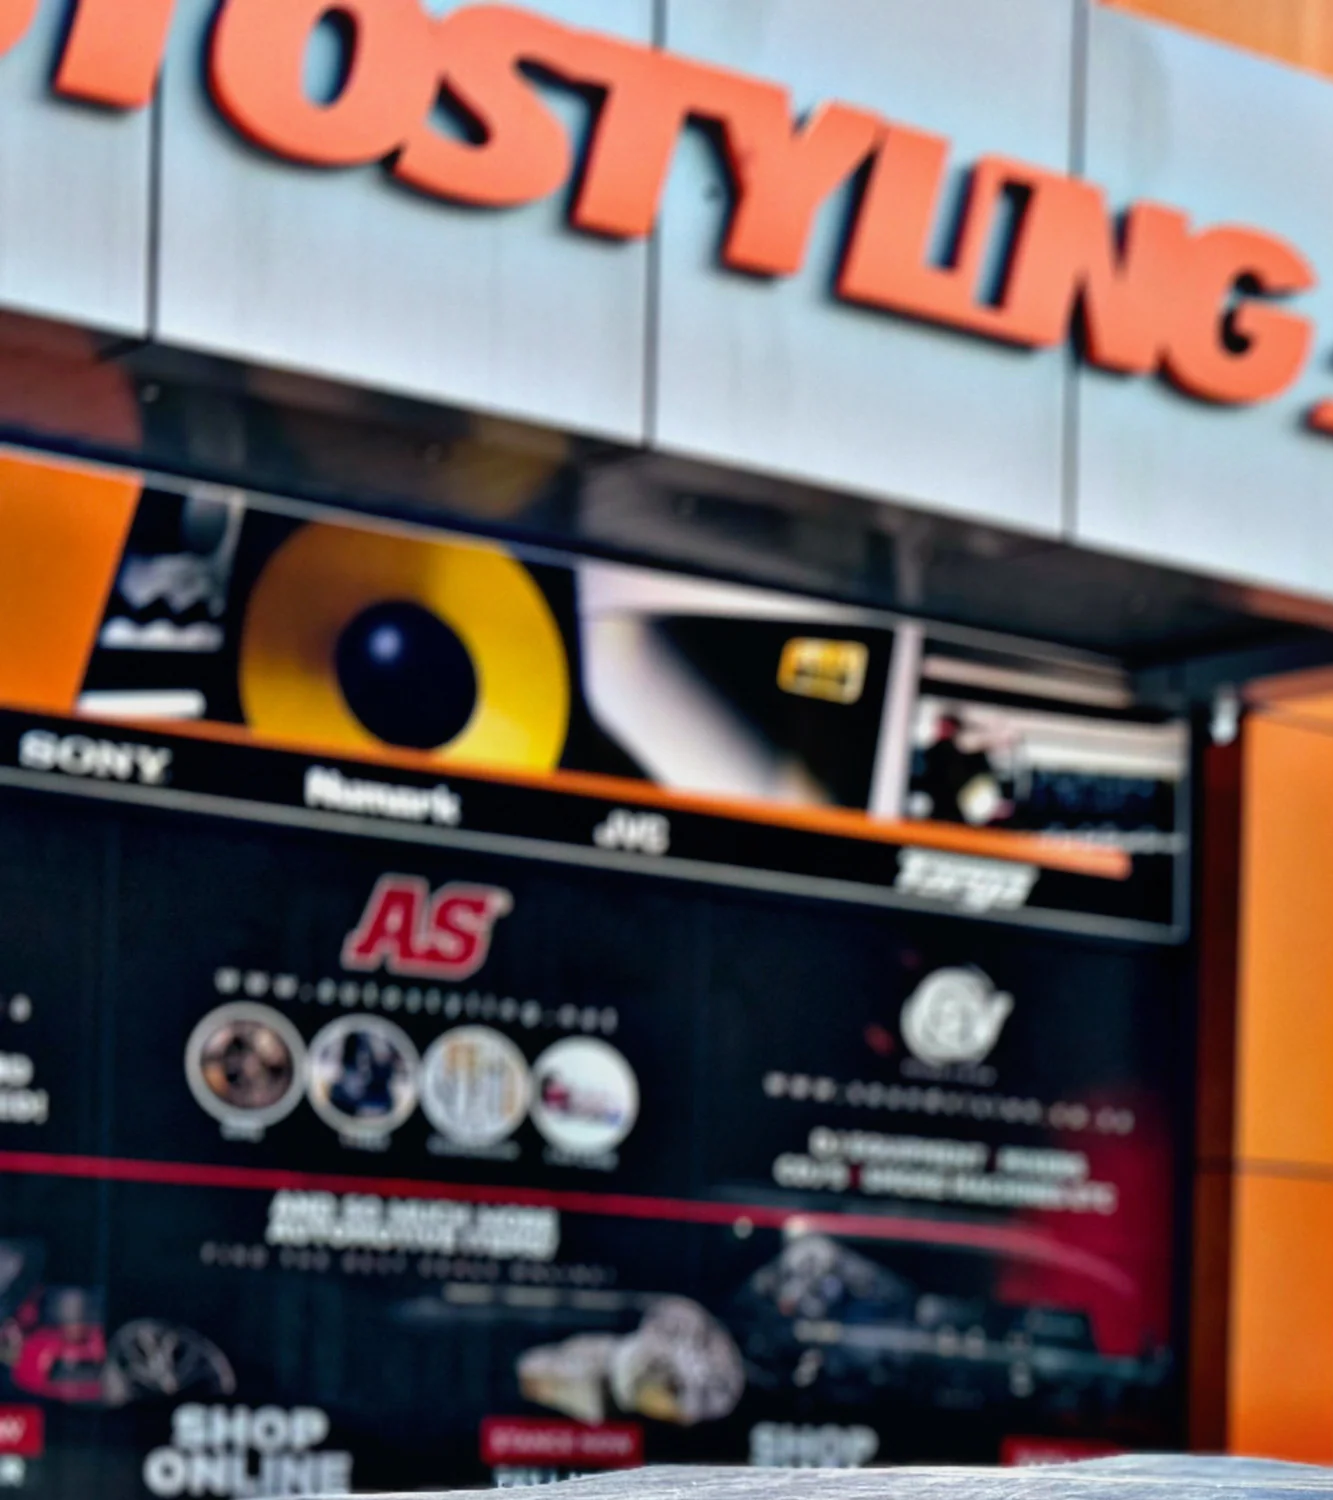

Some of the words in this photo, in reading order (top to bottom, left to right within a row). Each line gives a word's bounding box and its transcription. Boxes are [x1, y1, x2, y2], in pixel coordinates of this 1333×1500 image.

[18, 729, 172, 784] SONY
[341, 873, 512, 980] AS
[171, 1402, 329, 1451] SHOP
[142, 1446, 354, 1498] ONLINE
